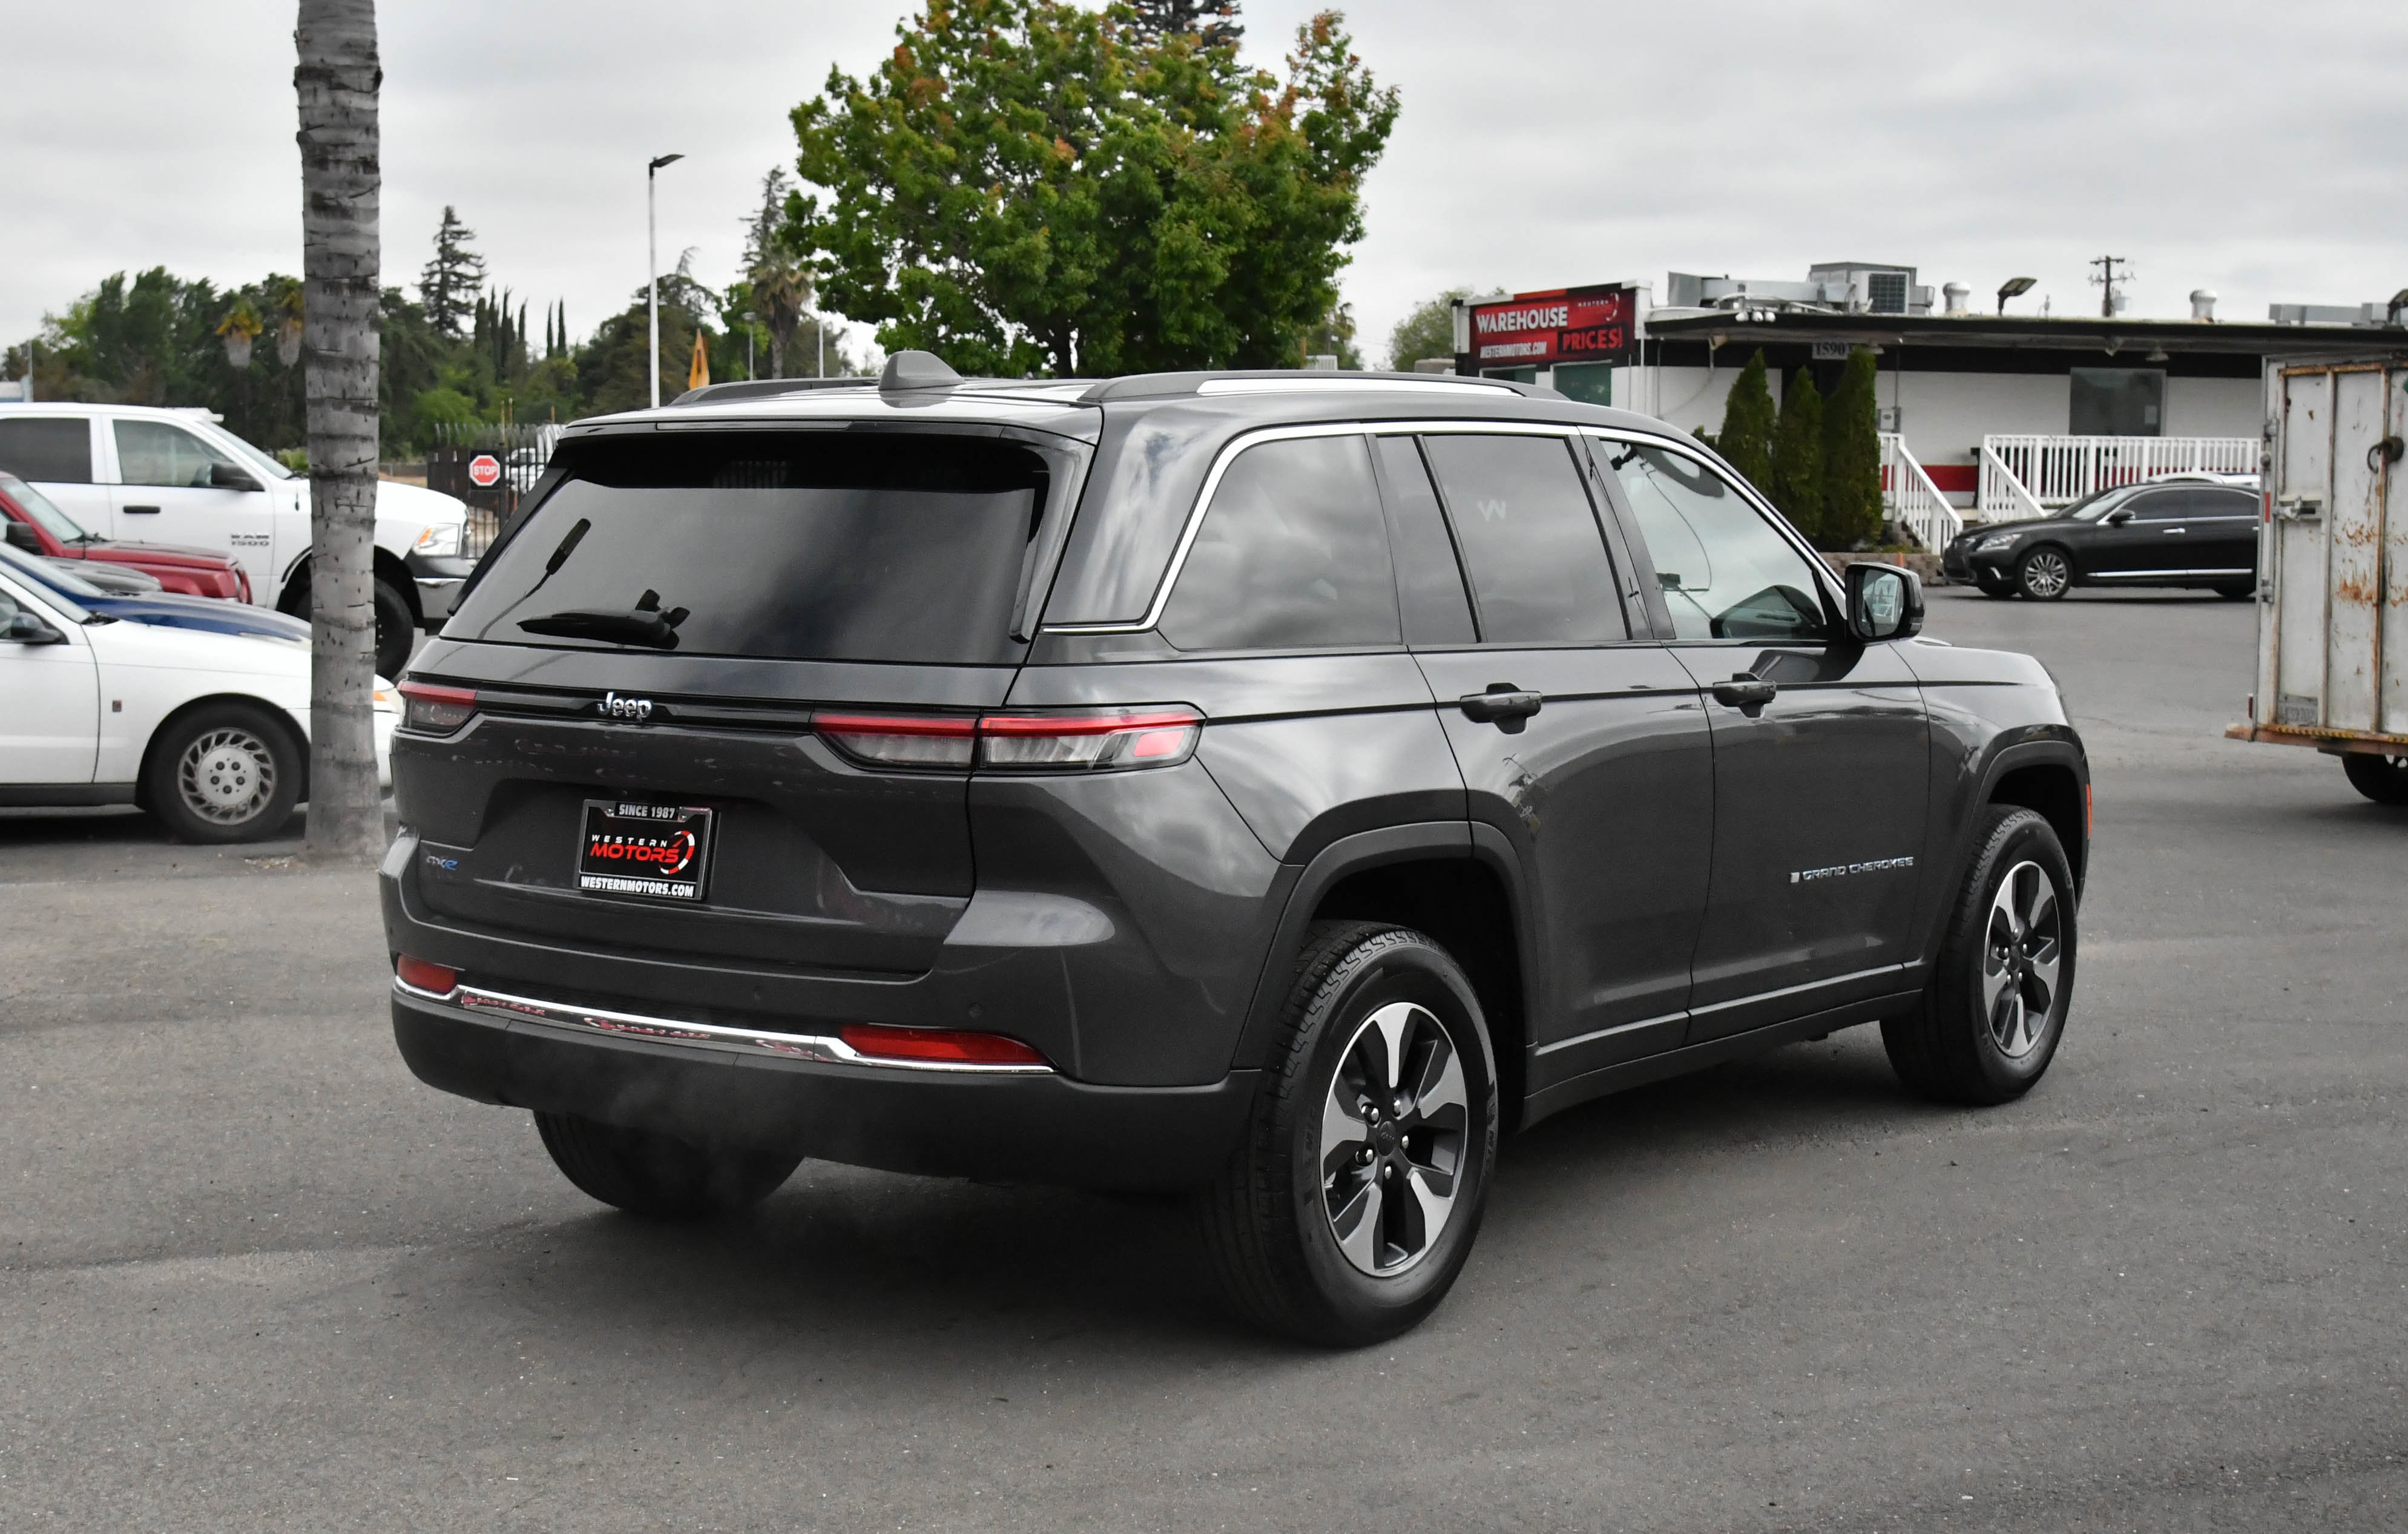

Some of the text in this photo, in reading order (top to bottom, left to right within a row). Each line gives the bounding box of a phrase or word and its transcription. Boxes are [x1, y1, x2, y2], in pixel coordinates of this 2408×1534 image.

[1476, 306, 1568, 334] WAREHOUSE
[1562, 327, 1623, 351] PRICES!
[474, 466, 498, 476] STOP
[597, 692, 652, 722] Jeep
[619, 803, 676, 818] SINCE 1987
[591, 834, 668, 848] WESTERN
[590, 842, 680, 864] MOTORS
[1802, 856, 1915, 880] GRAND CHEROKEE
[581, 875, 694, 897] WESTERNMOTORS.COM
